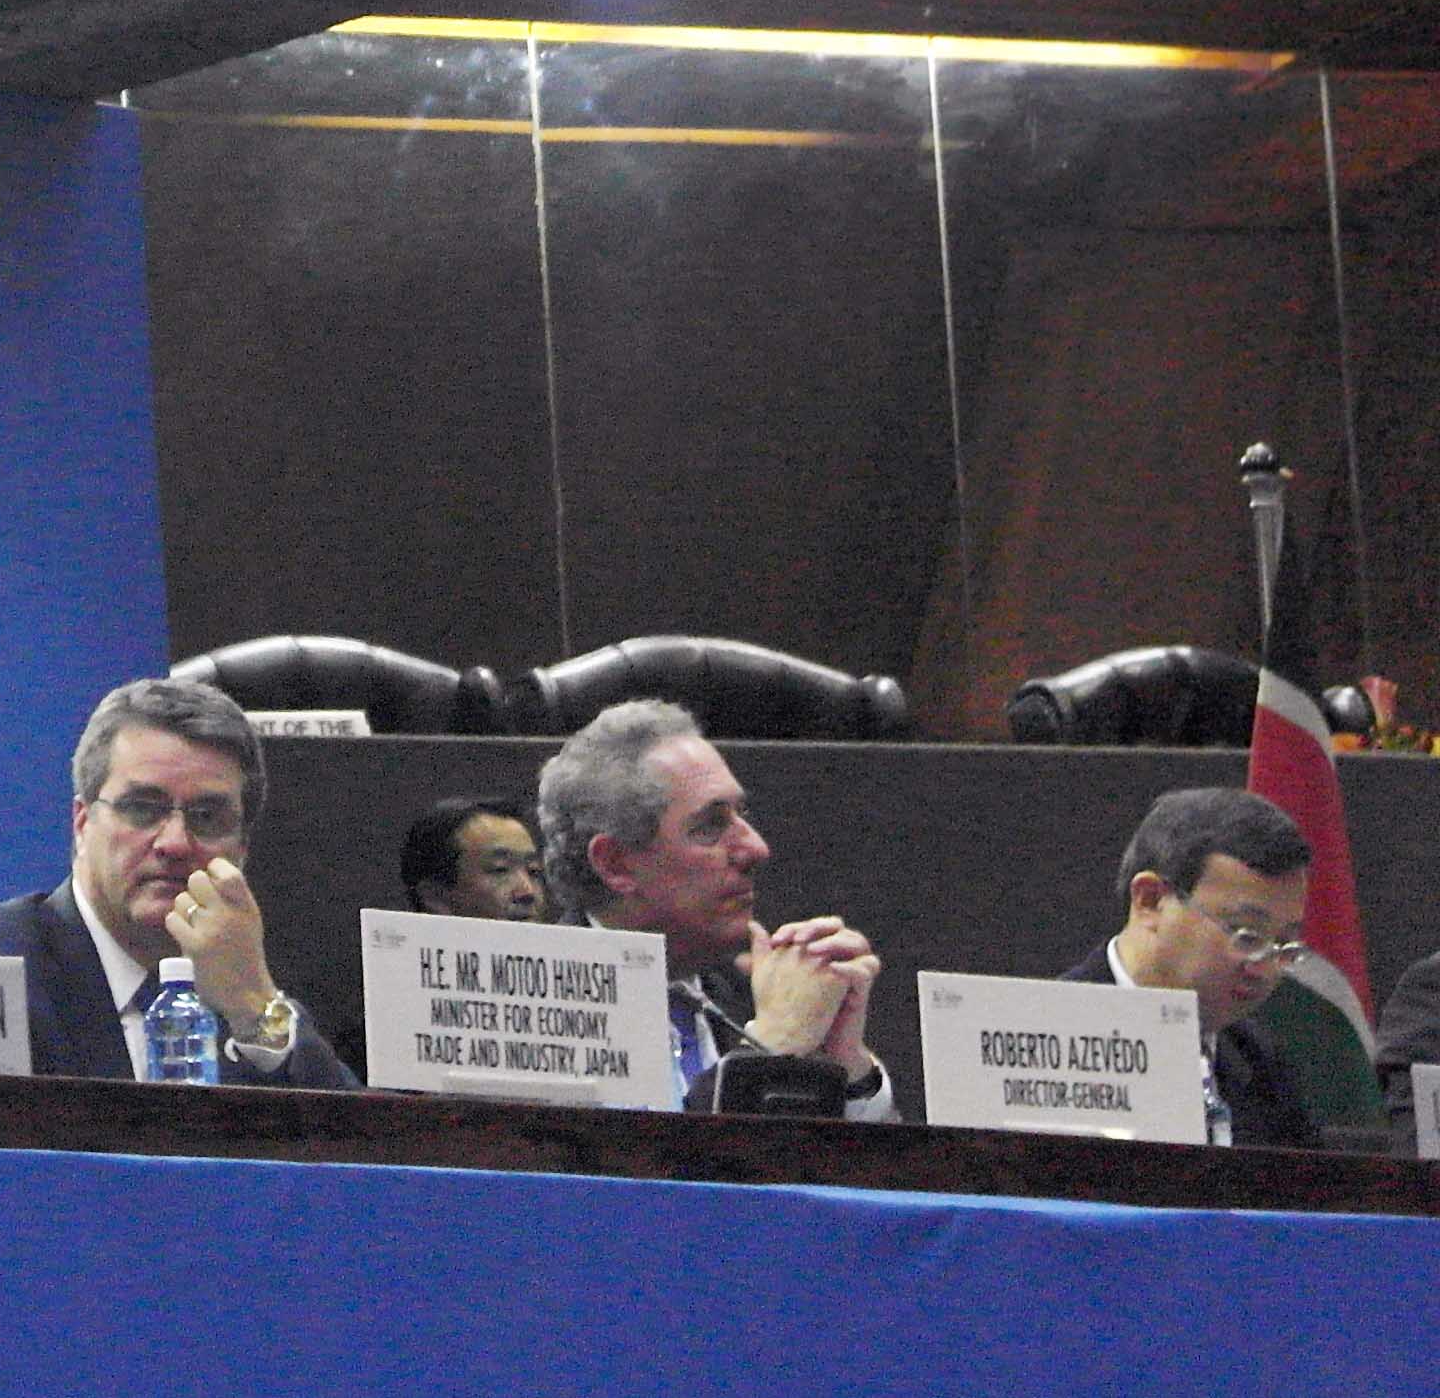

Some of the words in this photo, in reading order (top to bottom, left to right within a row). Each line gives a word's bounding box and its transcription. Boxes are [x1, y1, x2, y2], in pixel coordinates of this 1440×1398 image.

[456, 949, 486, 994] MR.
[490, 952, 549, 1000] MOTOO
[552, 958, 618, 1005] HAYASHI
[431, 997, 500, 1032] MINISTER
[504, 1001, 533, 1035] FOR
[536, 1004, 612, 1048] ECONOMY,
[414, 1031, 464, 1067] TRADE
[468, 1036, 501, 1069] AND
[504, 1039, 579, 1079] INDUSTRY,
[584, 1044, 631, 1080] JAPAN
[979, 1028, 1062, 1071] ROBERTO
[1002, 1077, 1134, 1113] DIRECTOR-GENERAL
